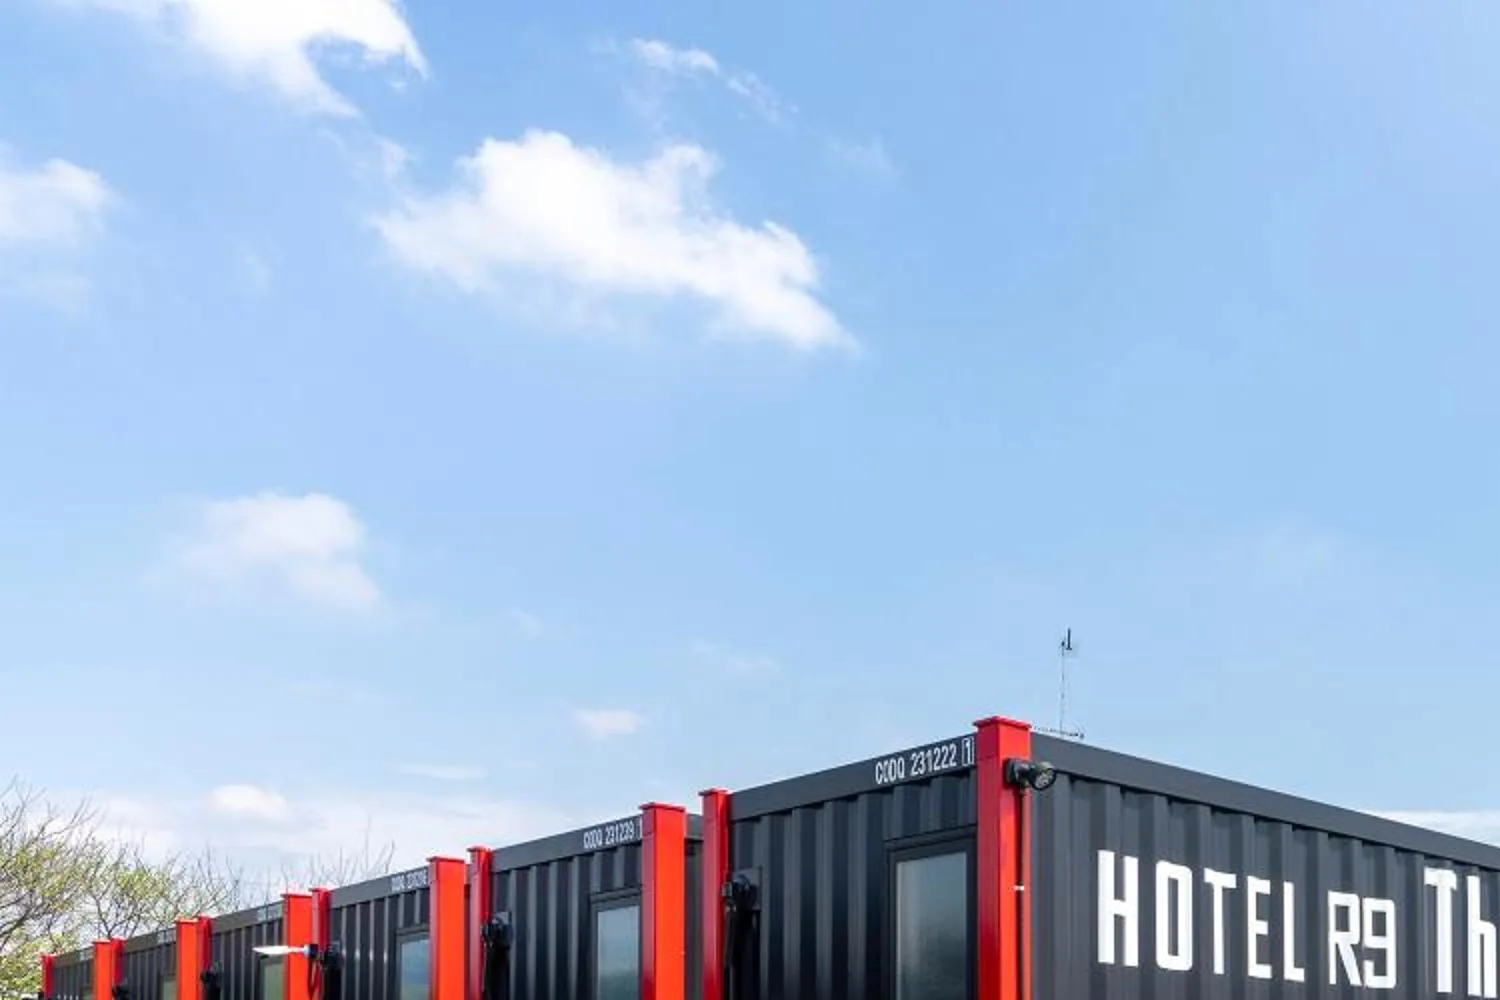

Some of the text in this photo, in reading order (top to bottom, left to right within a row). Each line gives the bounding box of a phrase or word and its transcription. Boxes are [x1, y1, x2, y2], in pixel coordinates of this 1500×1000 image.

[910, 743, 957, 777] 231222
[1098, 850, 1305, 982] HOTEL
[1328, 890, 1396, 989] R9
